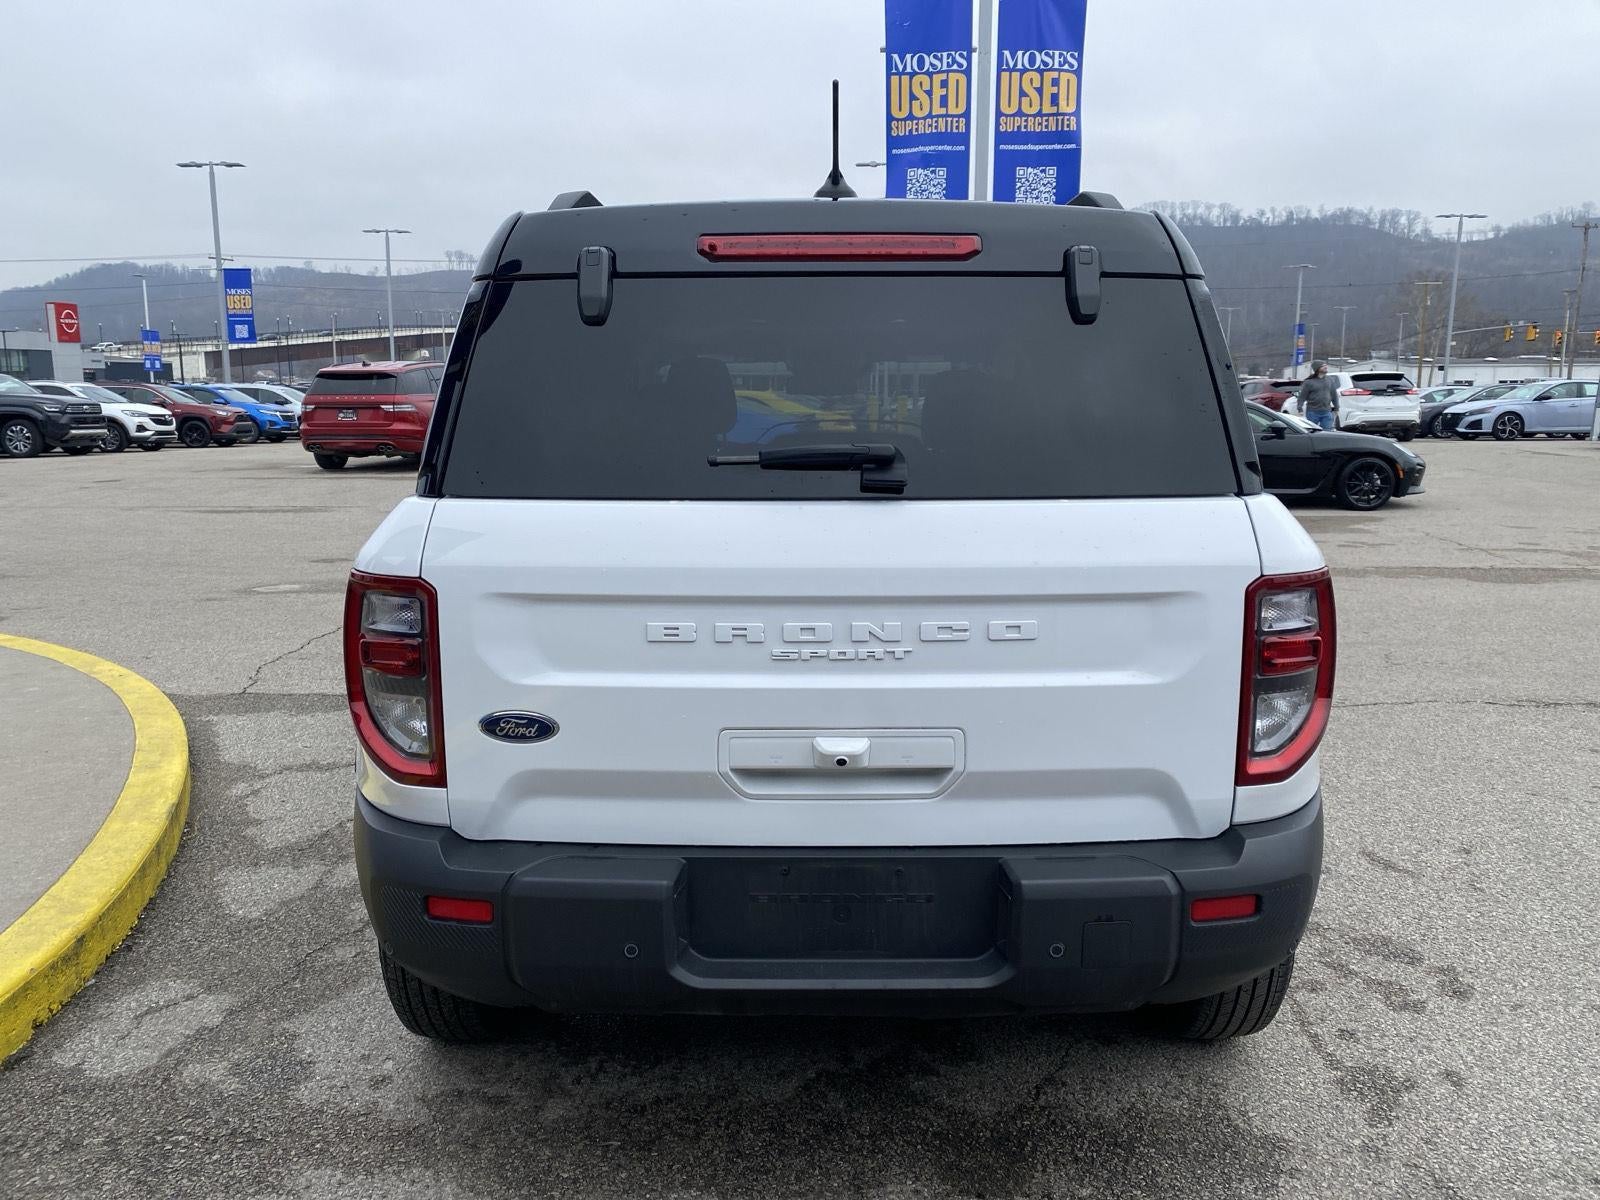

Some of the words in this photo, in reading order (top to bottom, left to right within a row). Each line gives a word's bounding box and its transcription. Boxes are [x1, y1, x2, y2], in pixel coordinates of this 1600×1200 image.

[891, 51, 968, 73] MOSES
[1001, 50, 1079, 71] MOSES
[890, 72, 968, 119] USED
[1000, 71, 1078, 115] USED
[891, 117, 966, 137] SUPERCENTER
[1000, 116, 1077, 132] SUPERCENTER
[892, 145, 966, 155] mosesusedsupercenter.com
[1000, 143, 1077, 152] mosesusedsupercenter.com
[226, 295, 252, 309] USED
[646, 620, 1039, 643] BRONCO
[771, 647, 913, 661] SPORT
[496, 718, 539, 737] Ford
